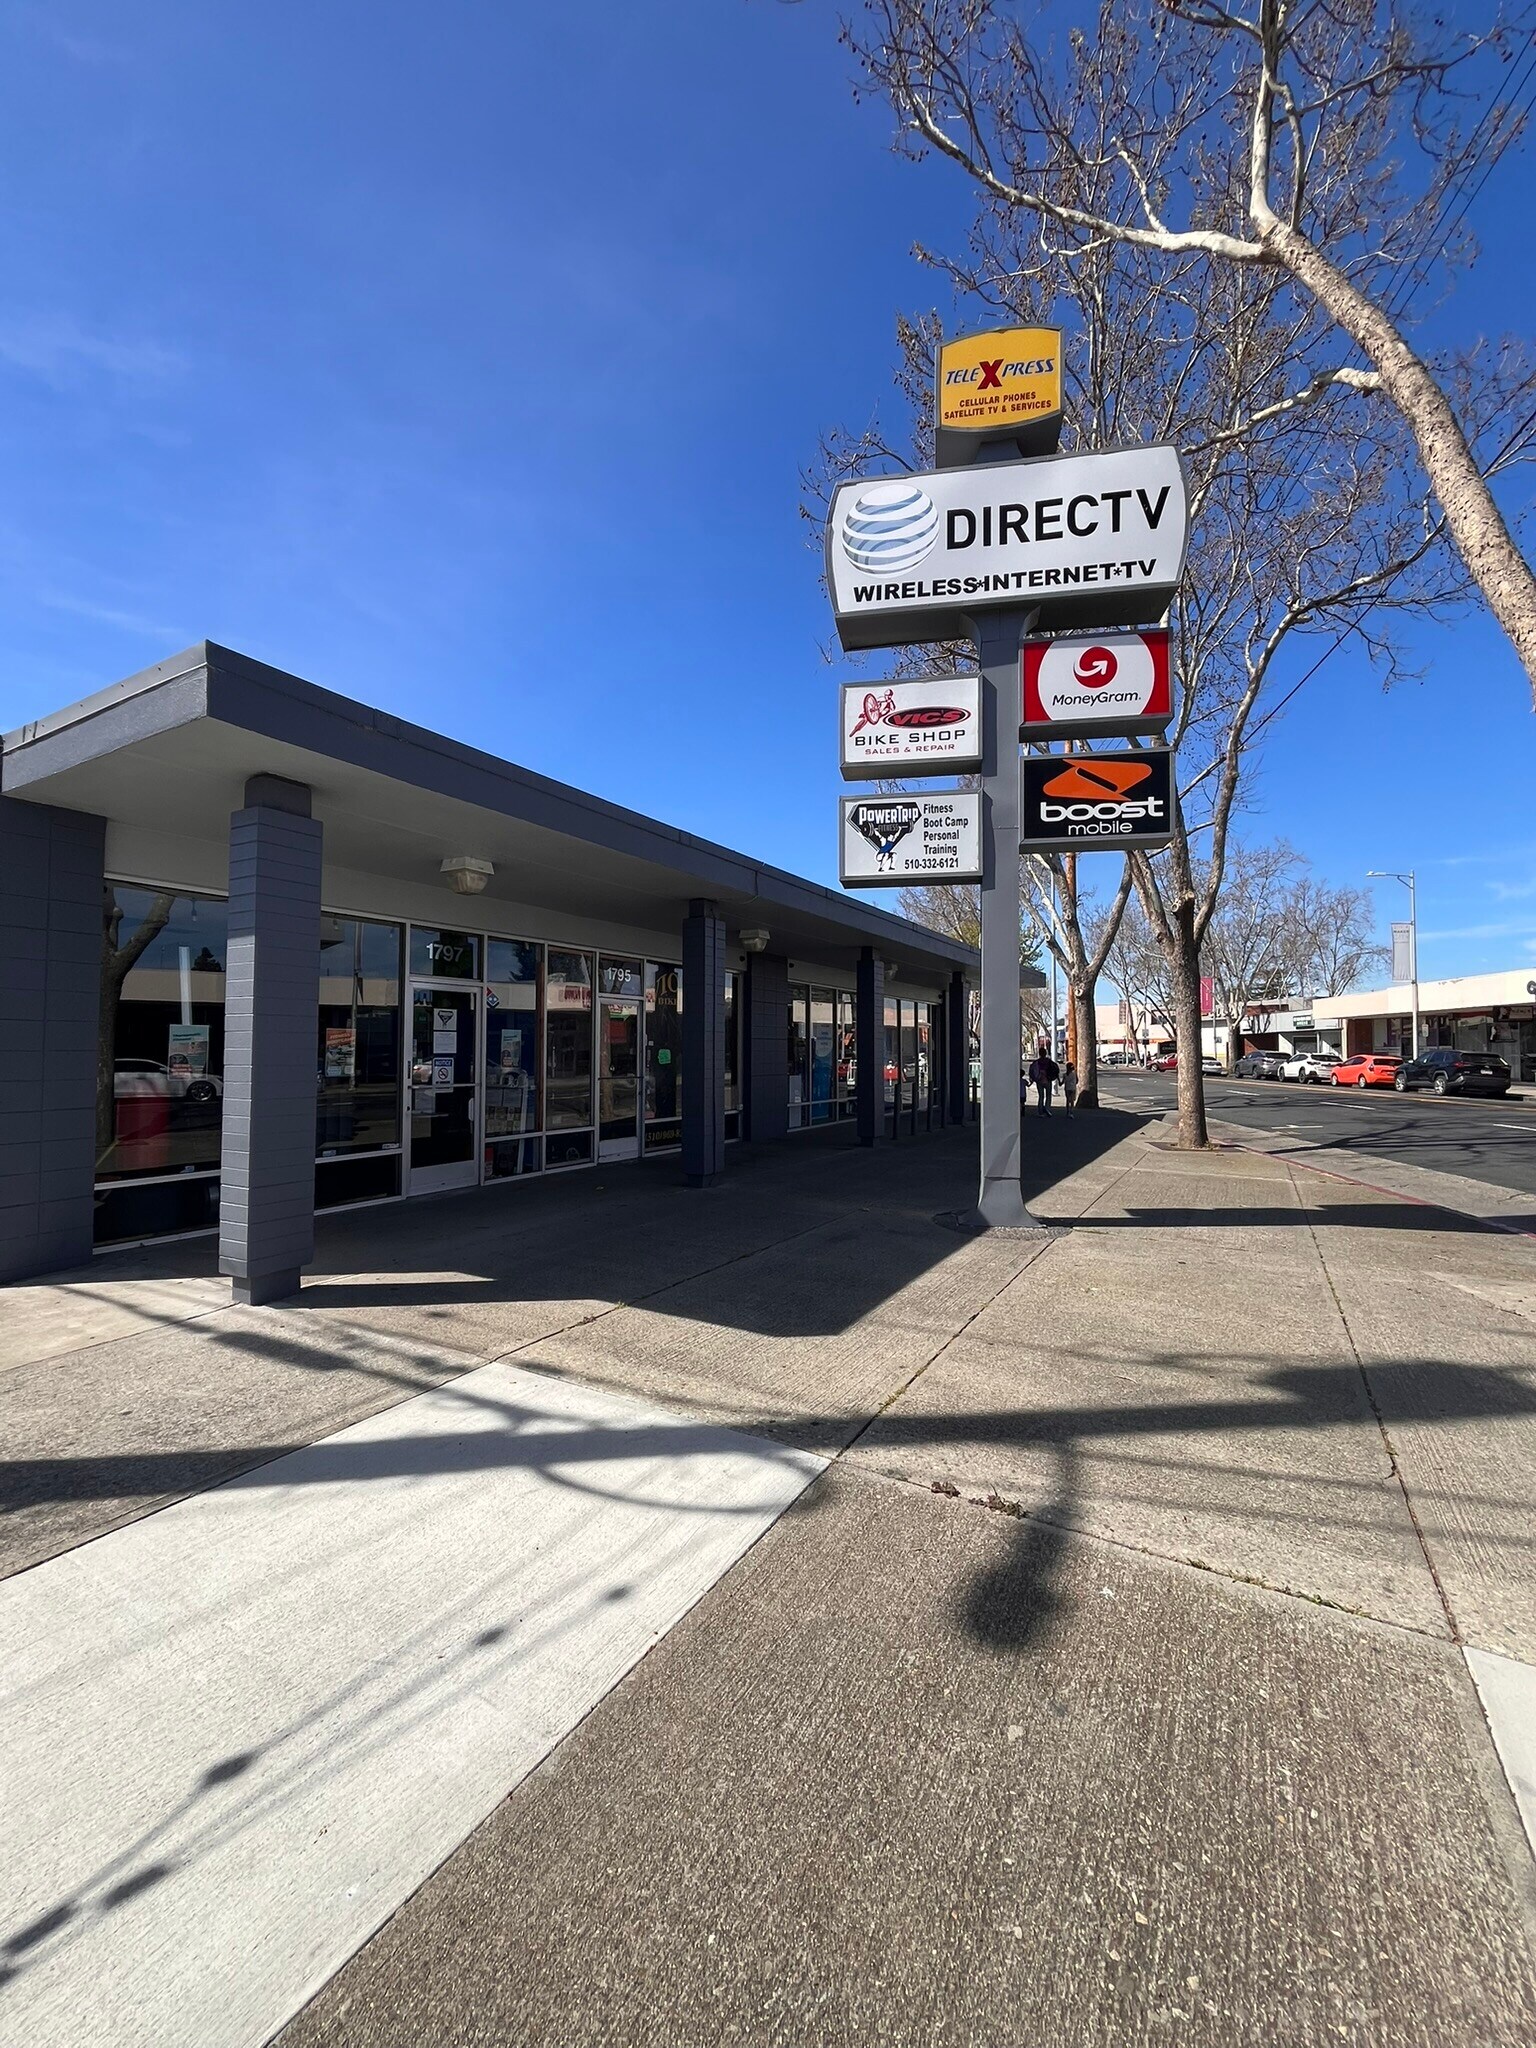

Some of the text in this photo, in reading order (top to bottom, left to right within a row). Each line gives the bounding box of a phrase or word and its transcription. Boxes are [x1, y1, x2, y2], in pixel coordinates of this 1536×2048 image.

[946, 358, 1055, 390] TELEXPRESS
[959, 391, 1036, 408] CELLULAR PHONES
[944, 400, 1052, 420] SATELLITE TV & SERVICES
[946, 485, 1172, 551] DIRECTV
[1052, 691, 1139, 707] MoneyGram
[855, 729, 966, 747] BIKE SHOP
[865, 747, 900, 755] SALES
[915, 743, 955, 752] REPAIR
[923, 803, 954, 814] Fitness
[1040, 796, 1164, 823] boost
[923, 816, 969, 829] Boot Camp
[1068, 820, 1133, 836] mobile
[923, 829, 960, 841] Personal
[924, 844, 958, 856] Training
[904, 858, 959, 869] 510-332-6121
[426, 942, 464, 963] 1797
[608, 967, 632, 983] 1795
